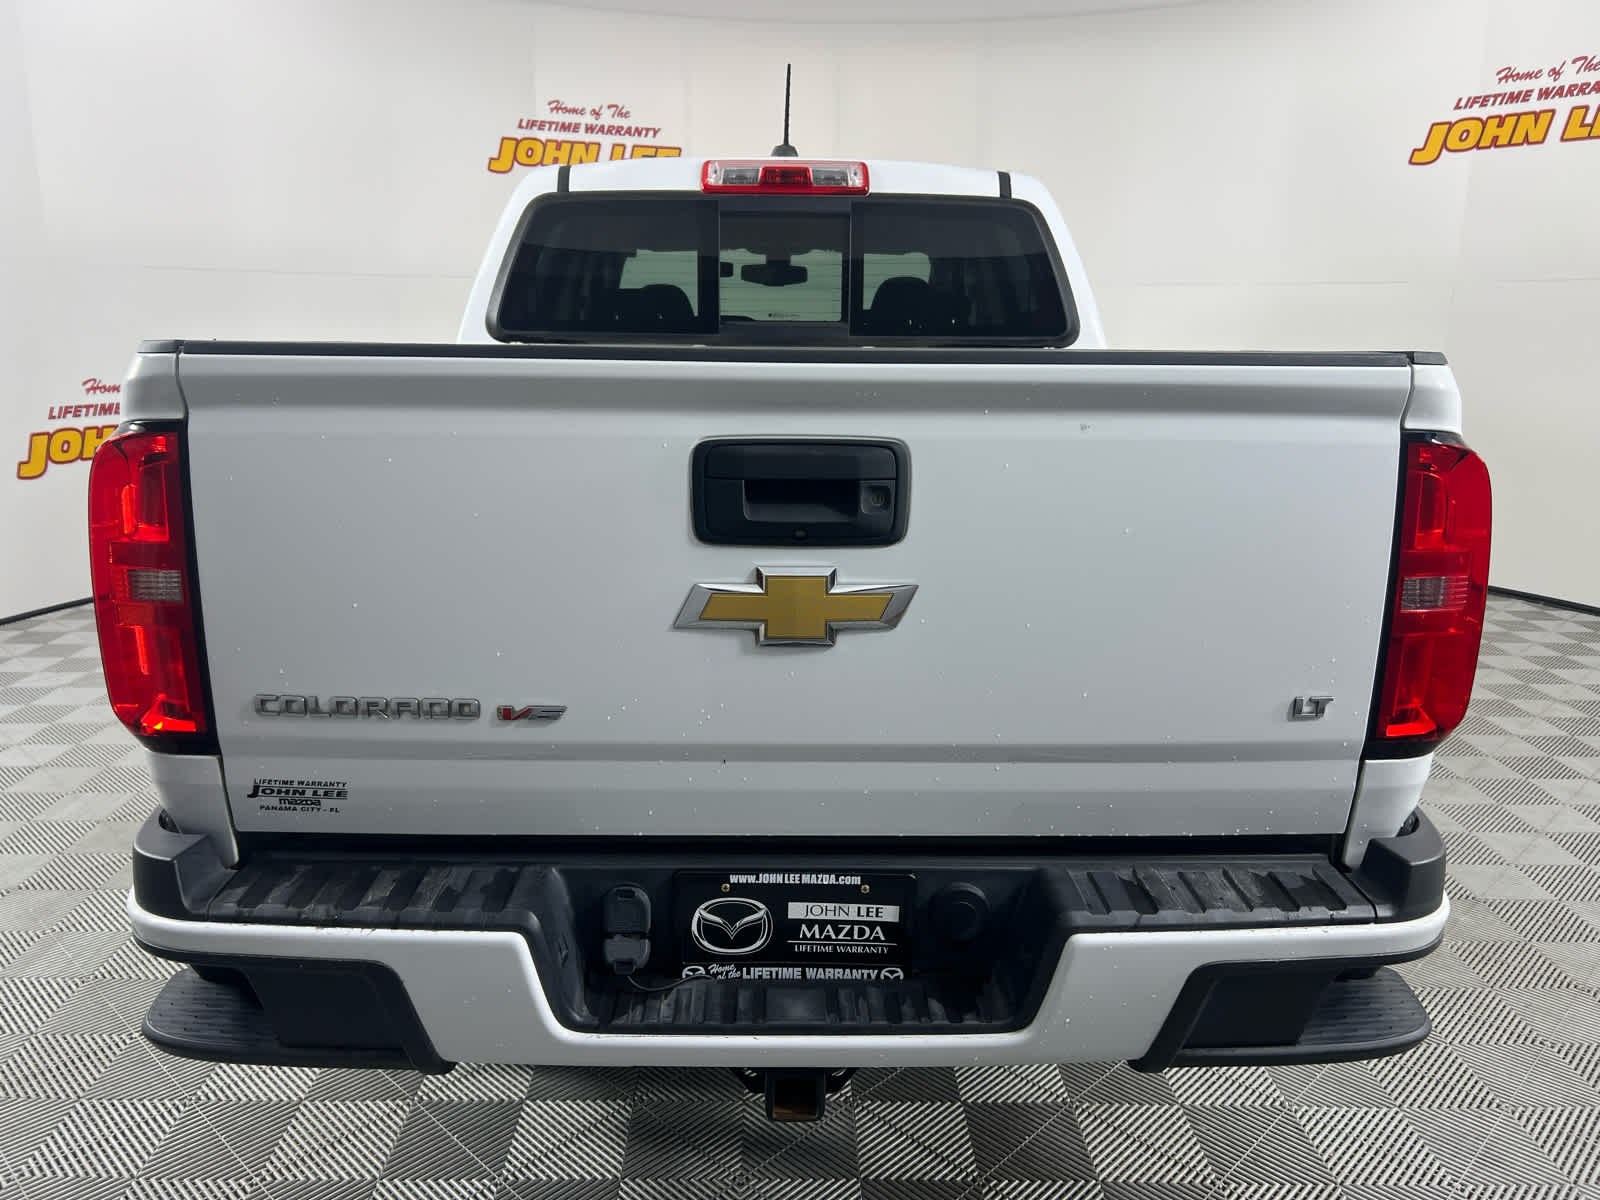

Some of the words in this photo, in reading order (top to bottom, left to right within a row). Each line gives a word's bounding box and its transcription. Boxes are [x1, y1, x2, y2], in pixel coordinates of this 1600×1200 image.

[1496, 66, 1544, 84] Home
[1548, 60, 1566, 81] of
[1453, 88, 1534, 110] LIFETIME
[1537, 80, 1600, 101] WARRA
[547, 99, 586, 116] Home
[590, 104, 603, 120] of
[607, 103, 631, 119] The
[517, 118, 580, 134] LIFETIME
[584, 123, 661, 138] WARRANTY
[1408, 108, 1556, 166] JOHN
[488, 136, 601, 174] JOHN
[82, 378, 120, 395] Hom
[16, 424, 119, 480] JOH
[254, 694, 481, 721] COLORADO
[1288, 695, 1335, 721] LT
[247, 785, 307, 798] JOHN
[311, 788, 349, 798] LEE
[254, 778, 295, 786] LIFETIME
[297, 780, 348, 788] WARRANTY
[805, 904, 850, 917] JOHN
[857, 905, 884, 919] LEE
[800, 923, 886, 941] MAZDA
[795, 944, 834, 953] LIFETIME
[836, 945, 888, 954] WARRANTY
[742, 967, 802, 980] LIFETIME
[805, 967, 879, 980] WARRANTY
